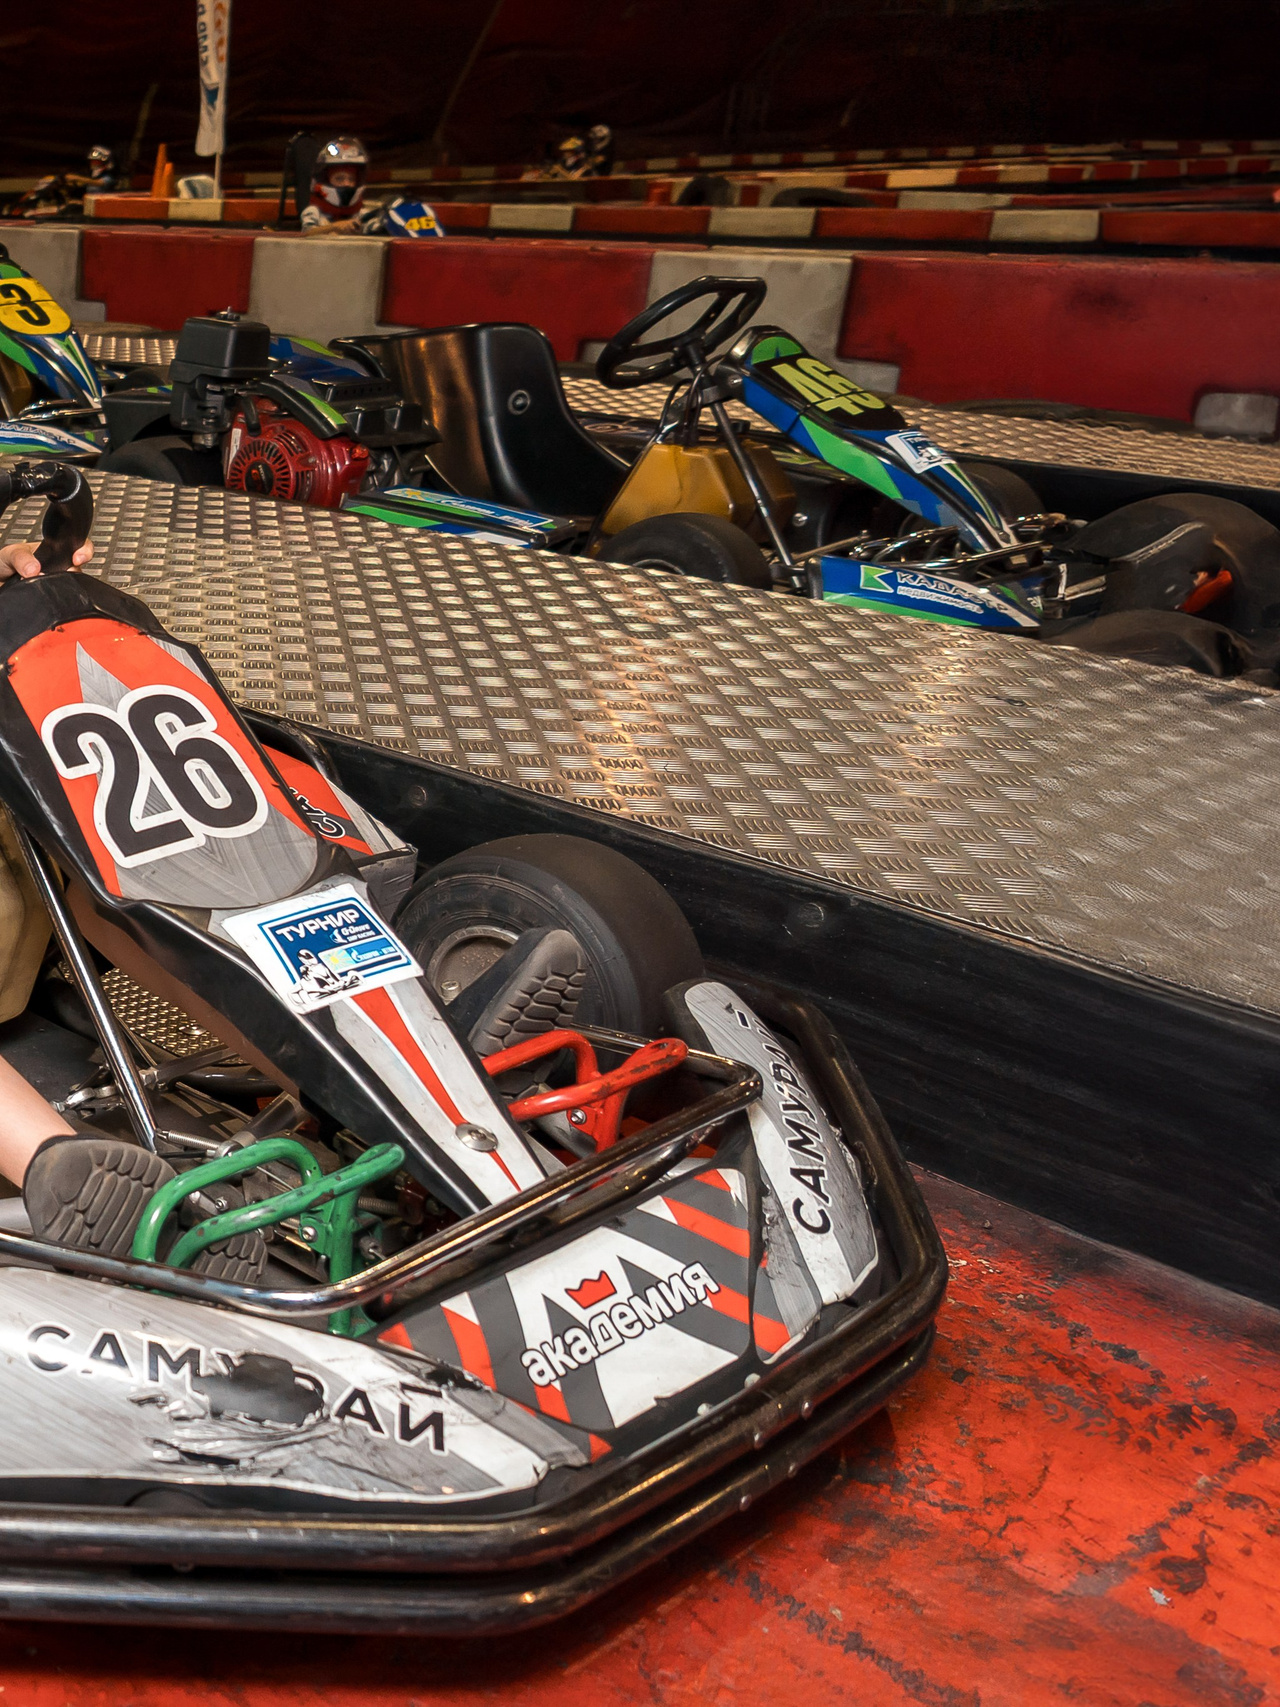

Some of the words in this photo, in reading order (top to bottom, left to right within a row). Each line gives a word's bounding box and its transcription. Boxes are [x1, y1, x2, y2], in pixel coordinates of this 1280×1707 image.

[40, 684, 269, 869] 26
[275, 908, 360, 942] ТУРНИР
[520, 1260, 721, 1387] академия
